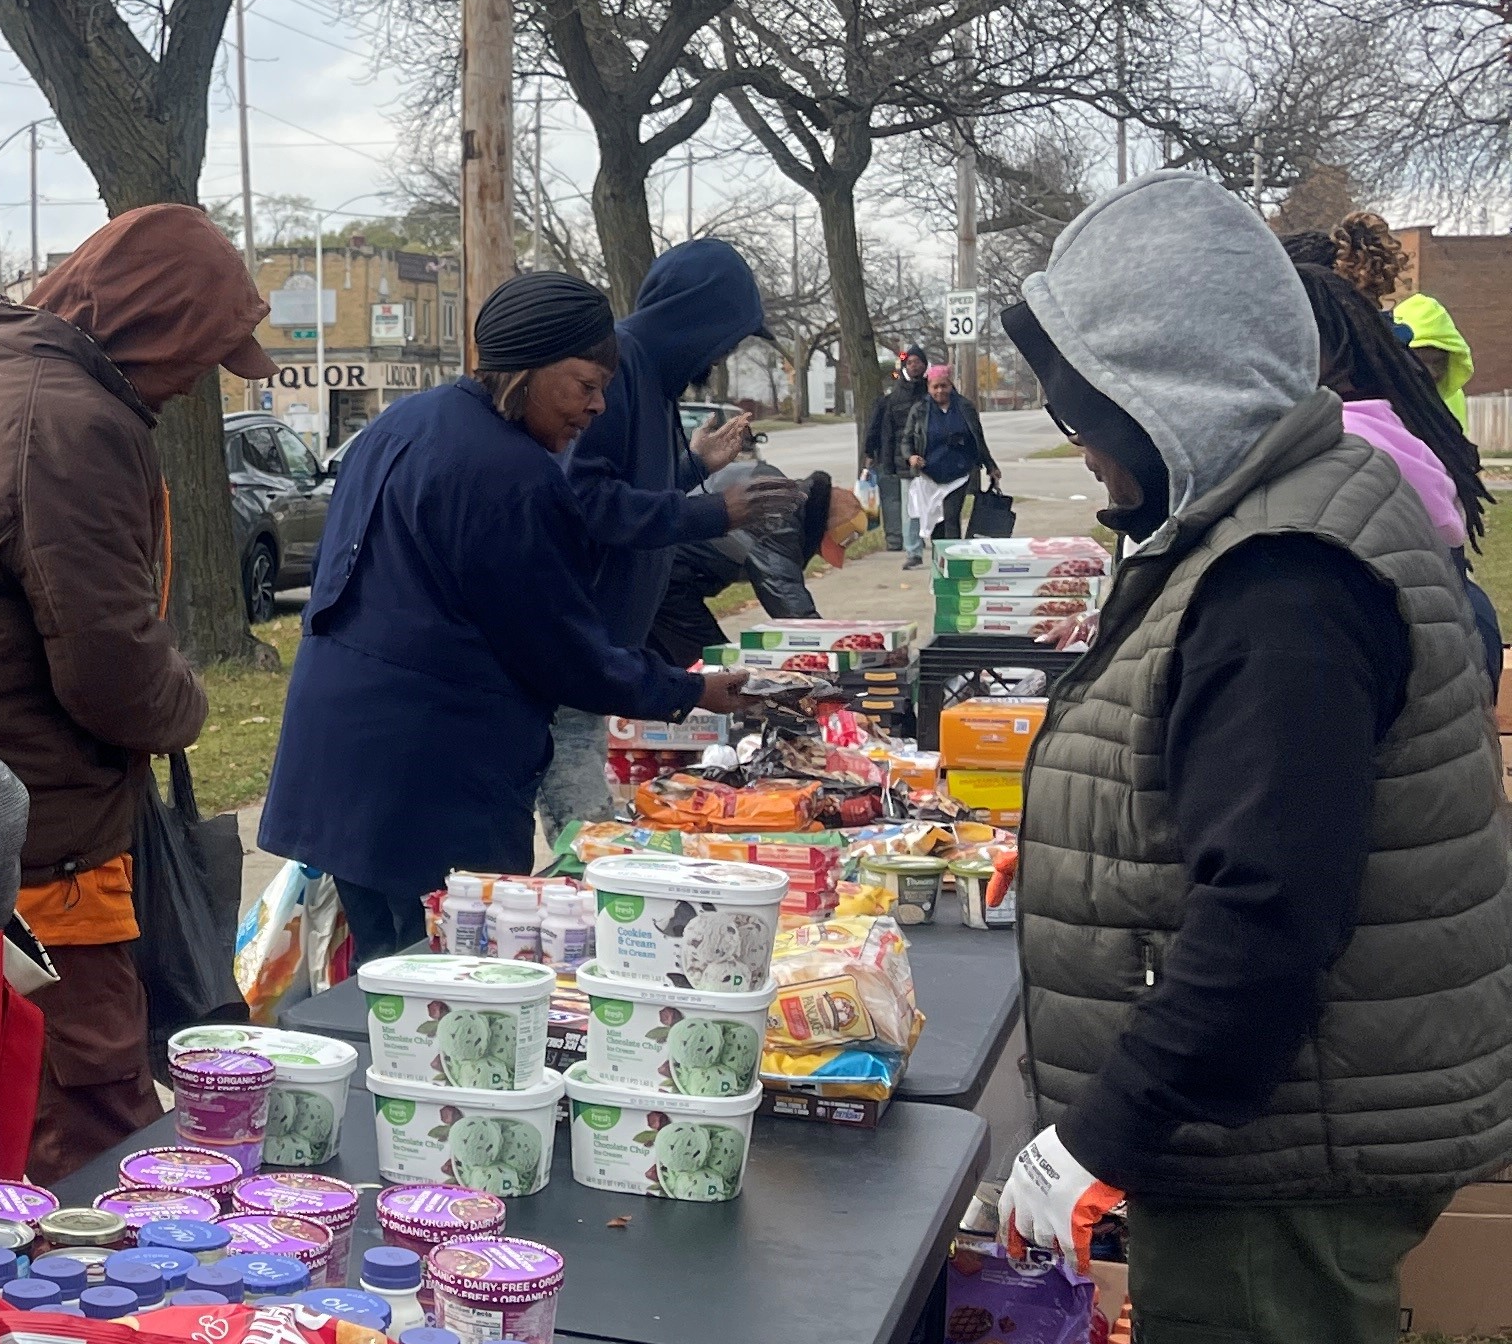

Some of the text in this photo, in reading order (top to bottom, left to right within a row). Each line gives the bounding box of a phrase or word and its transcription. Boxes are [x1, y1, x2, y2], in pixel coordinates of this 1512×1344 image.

[950, 317, 973, 335] 30
[386, 364, 417, 386] LIQUOR
[609, 716, 635, 740] G
[617, 927, 652, 939] Cookies
[625, 938, 656, 949] Cream
[629, 949, 656, 958] Cream
[641, 1041, 663, 1053] Chip
[217, 1076, 257, 1085] ORGANIC
[629, 1145, 650, 1156] Chip
[1039, 1158, 1061, 1181] GRIP
[464, 1279, 530, 1293] DAIRY-FREE
[471, 1309, 493, 1319] Facts
